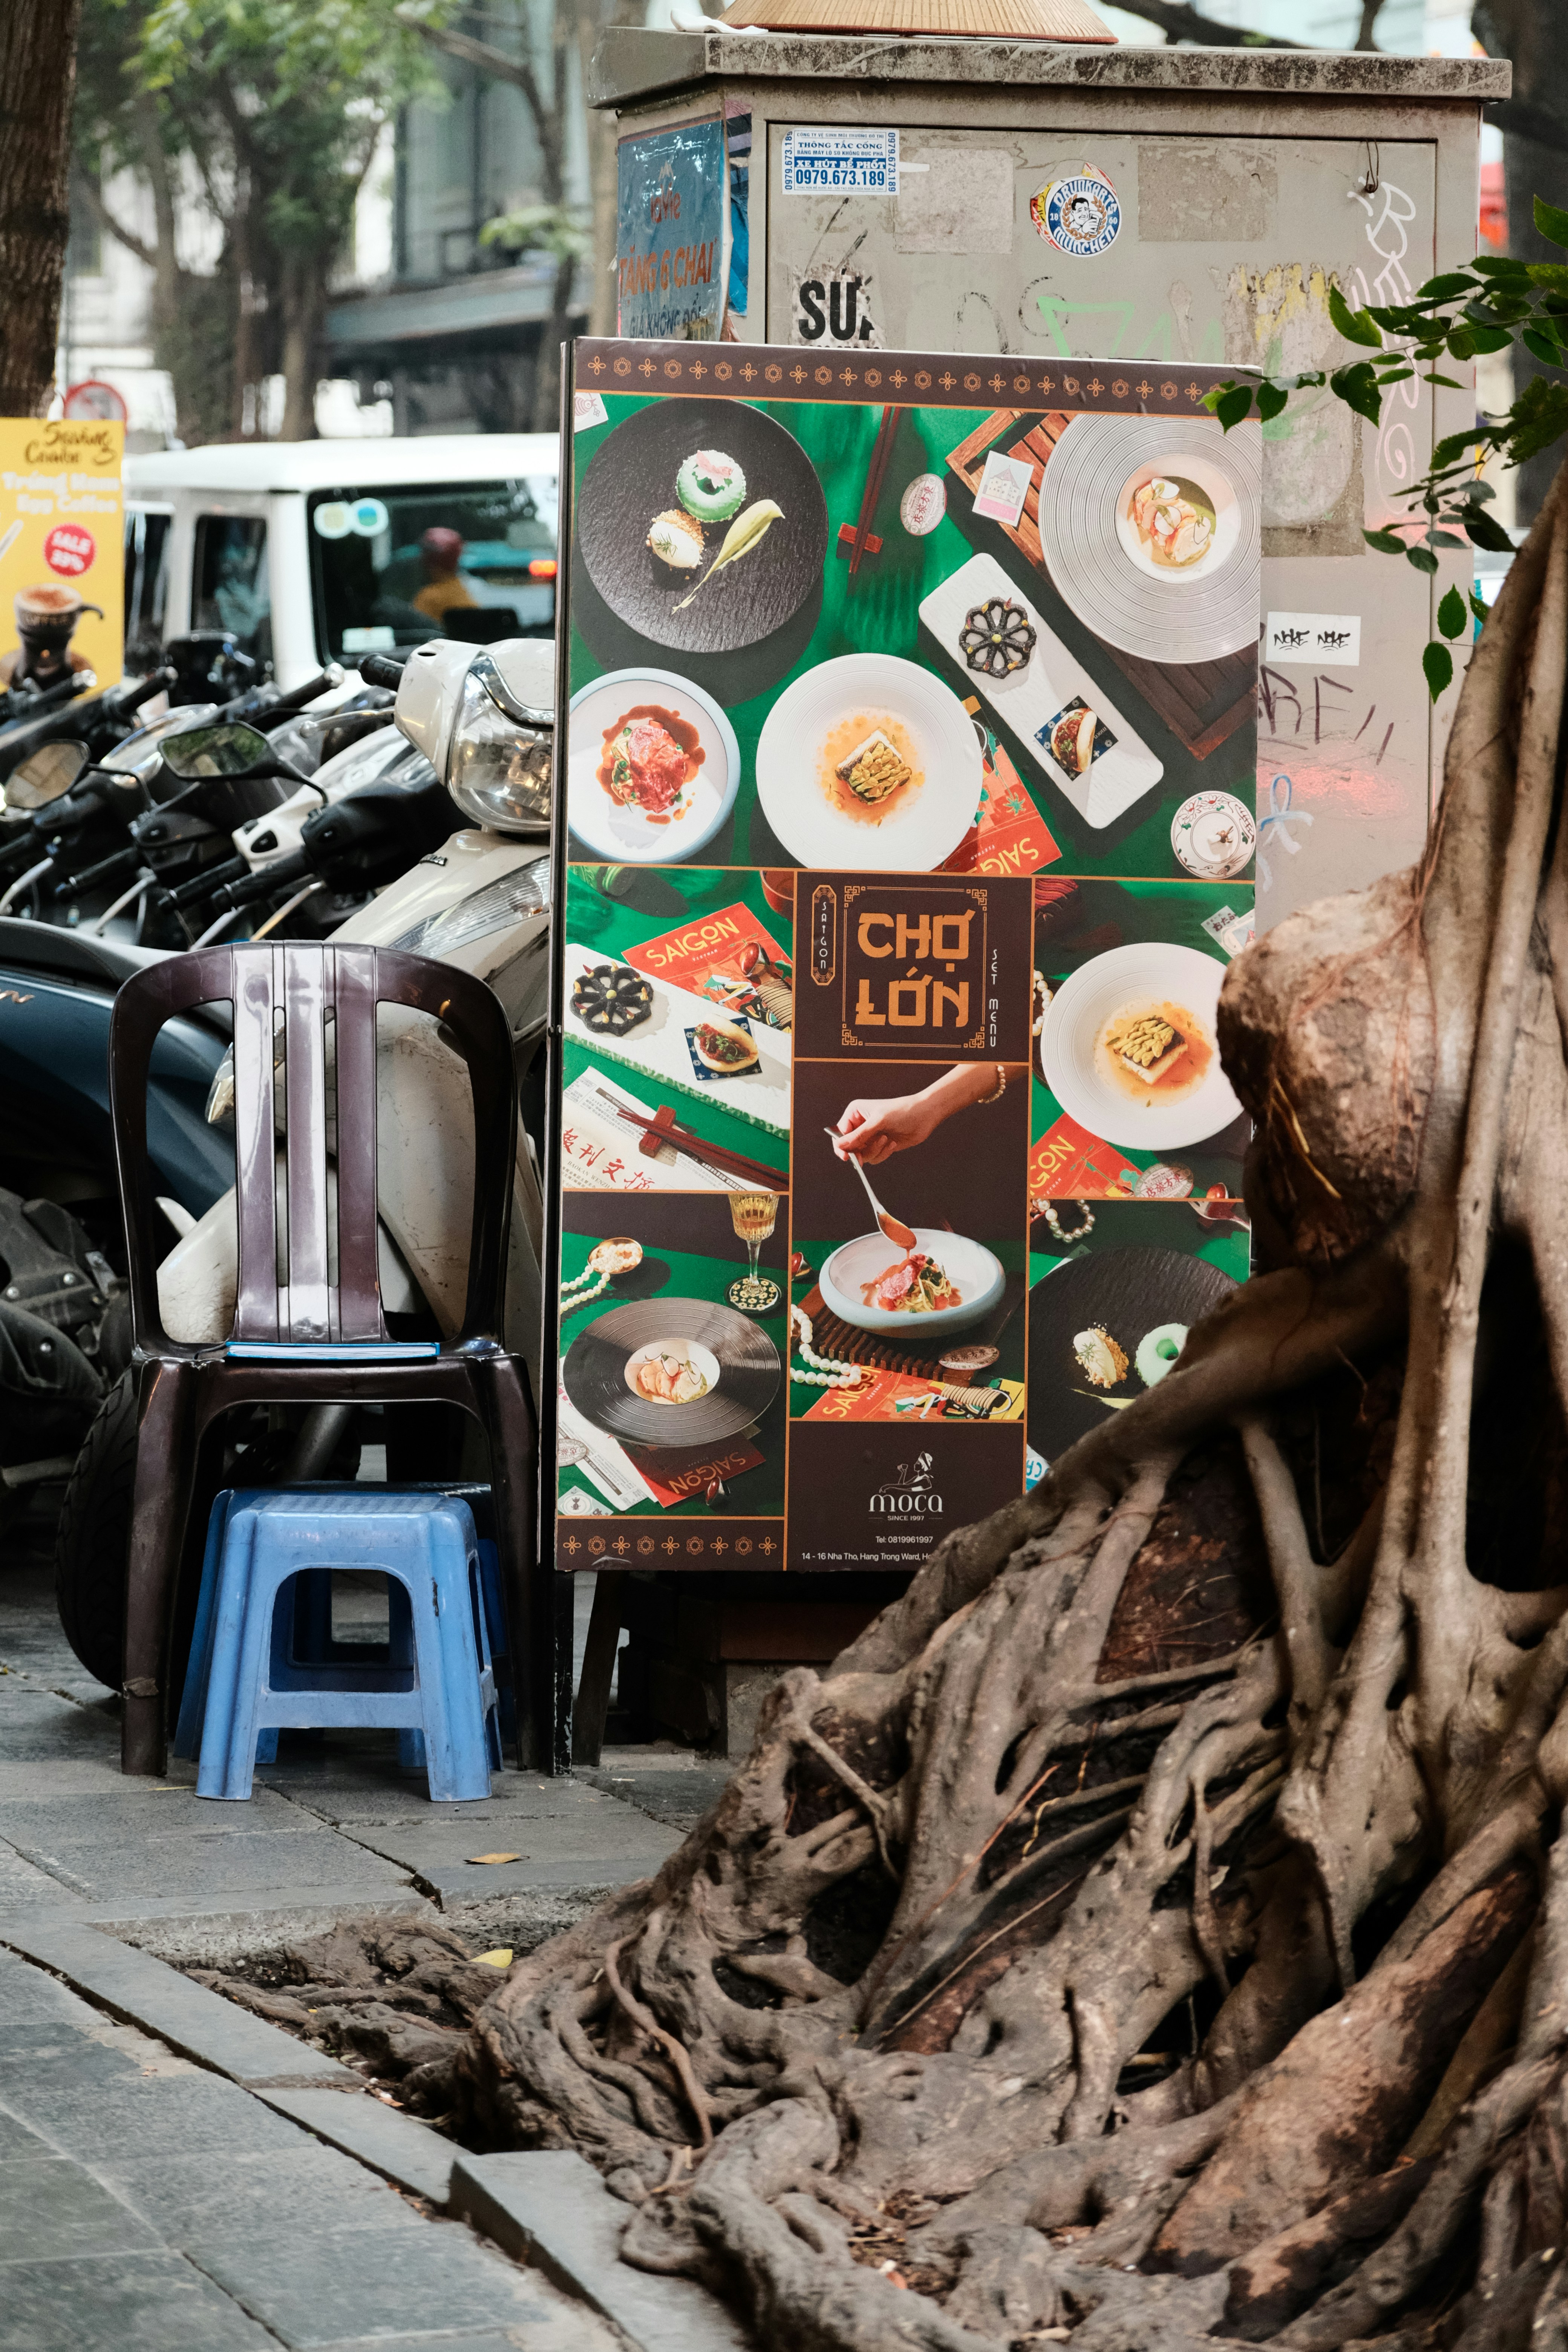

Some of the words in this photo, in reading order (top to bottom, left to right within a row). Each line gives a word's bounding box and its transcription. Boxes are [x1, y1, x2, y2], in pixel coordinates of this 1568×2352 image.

[814, 159, 837, 168] HÚT
[839, 158, 854, 168] BỂ
[856, 159, 885, 169] PHỐT
[856, 141, 882, 149] CỐNG
[796, 169, 884, 185] 0979.673.189
[1054, 179, 1117, 214] DRUNKARTS
[1050, 213, 1059, 221] 18
[661, 250, 671, 290] 6
[646, 917, 740, 967] SAIGON
[819, 902, 828, 969] SAIGON
[858, 909, 976, 972] CHỢ
[855, 966, 969, 1027] LỚN
[989, 998, 998, 1047] MENU
[668, 1452, 746, 1494] SAIGON
[868, 1494, 944, 1513] moca
[844, 1553, 859, 1561] Tho,
[860, 1553, 879, 1561] Hang
[880, 1553, 900, 1562] Trong
